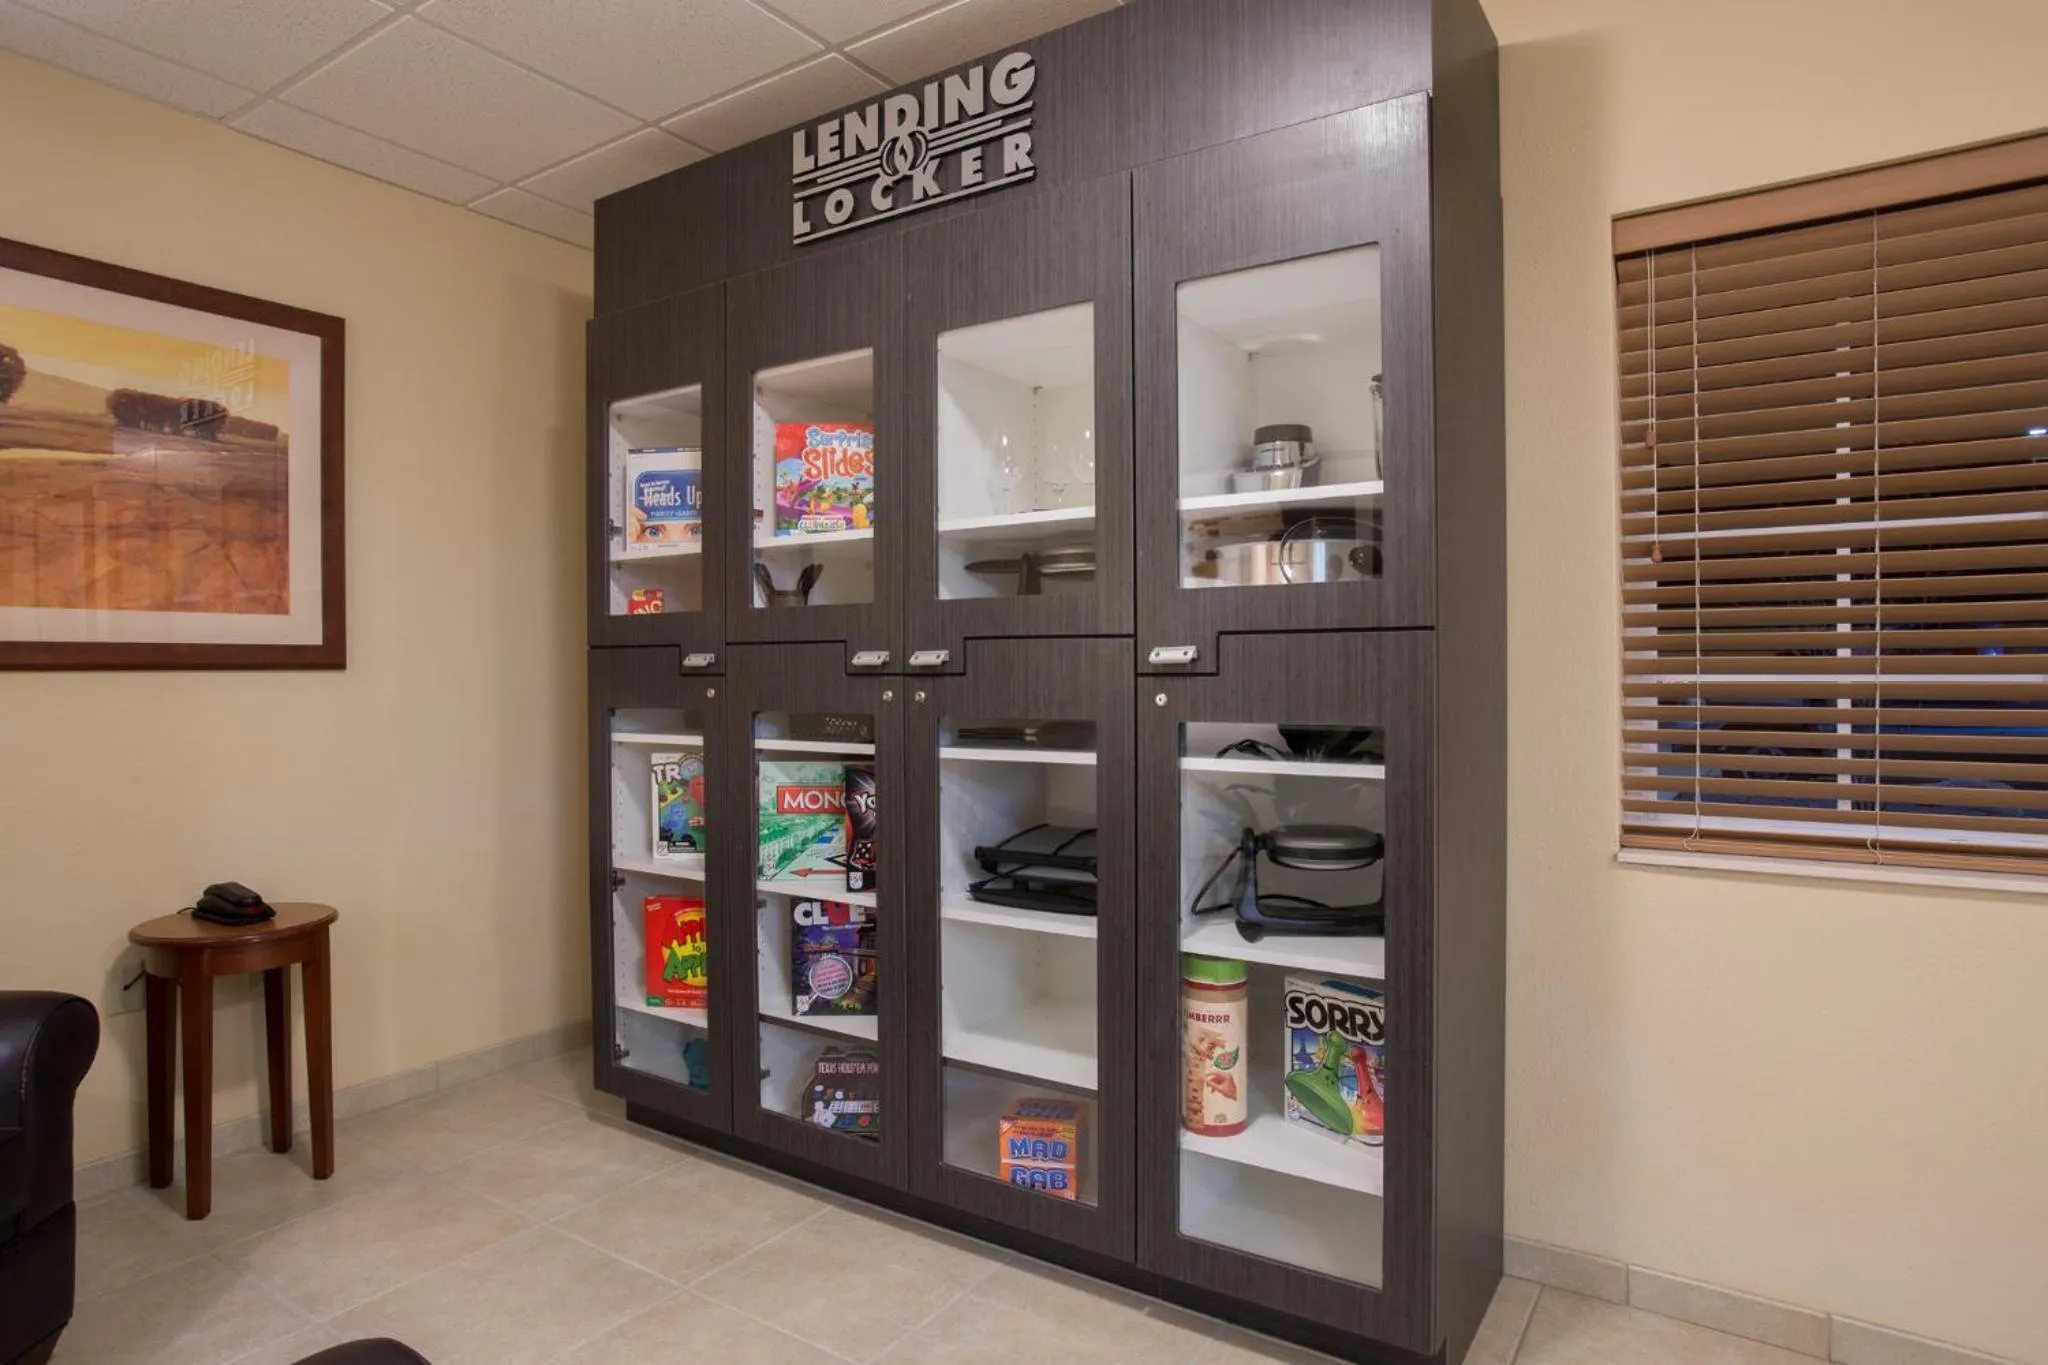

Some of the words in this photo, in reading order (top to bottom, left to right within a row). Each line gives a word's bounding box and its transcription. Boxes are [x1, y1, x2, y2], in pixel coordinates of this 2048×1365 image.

[792, 51, 1036, 175] LENDING
[793, 131, 1036, 236] LOCKER
[642, 485, 682, 507] Heads
[793, 901, 867, 926] CLUE
[1007, 1136, 1069, 1161] MAD
